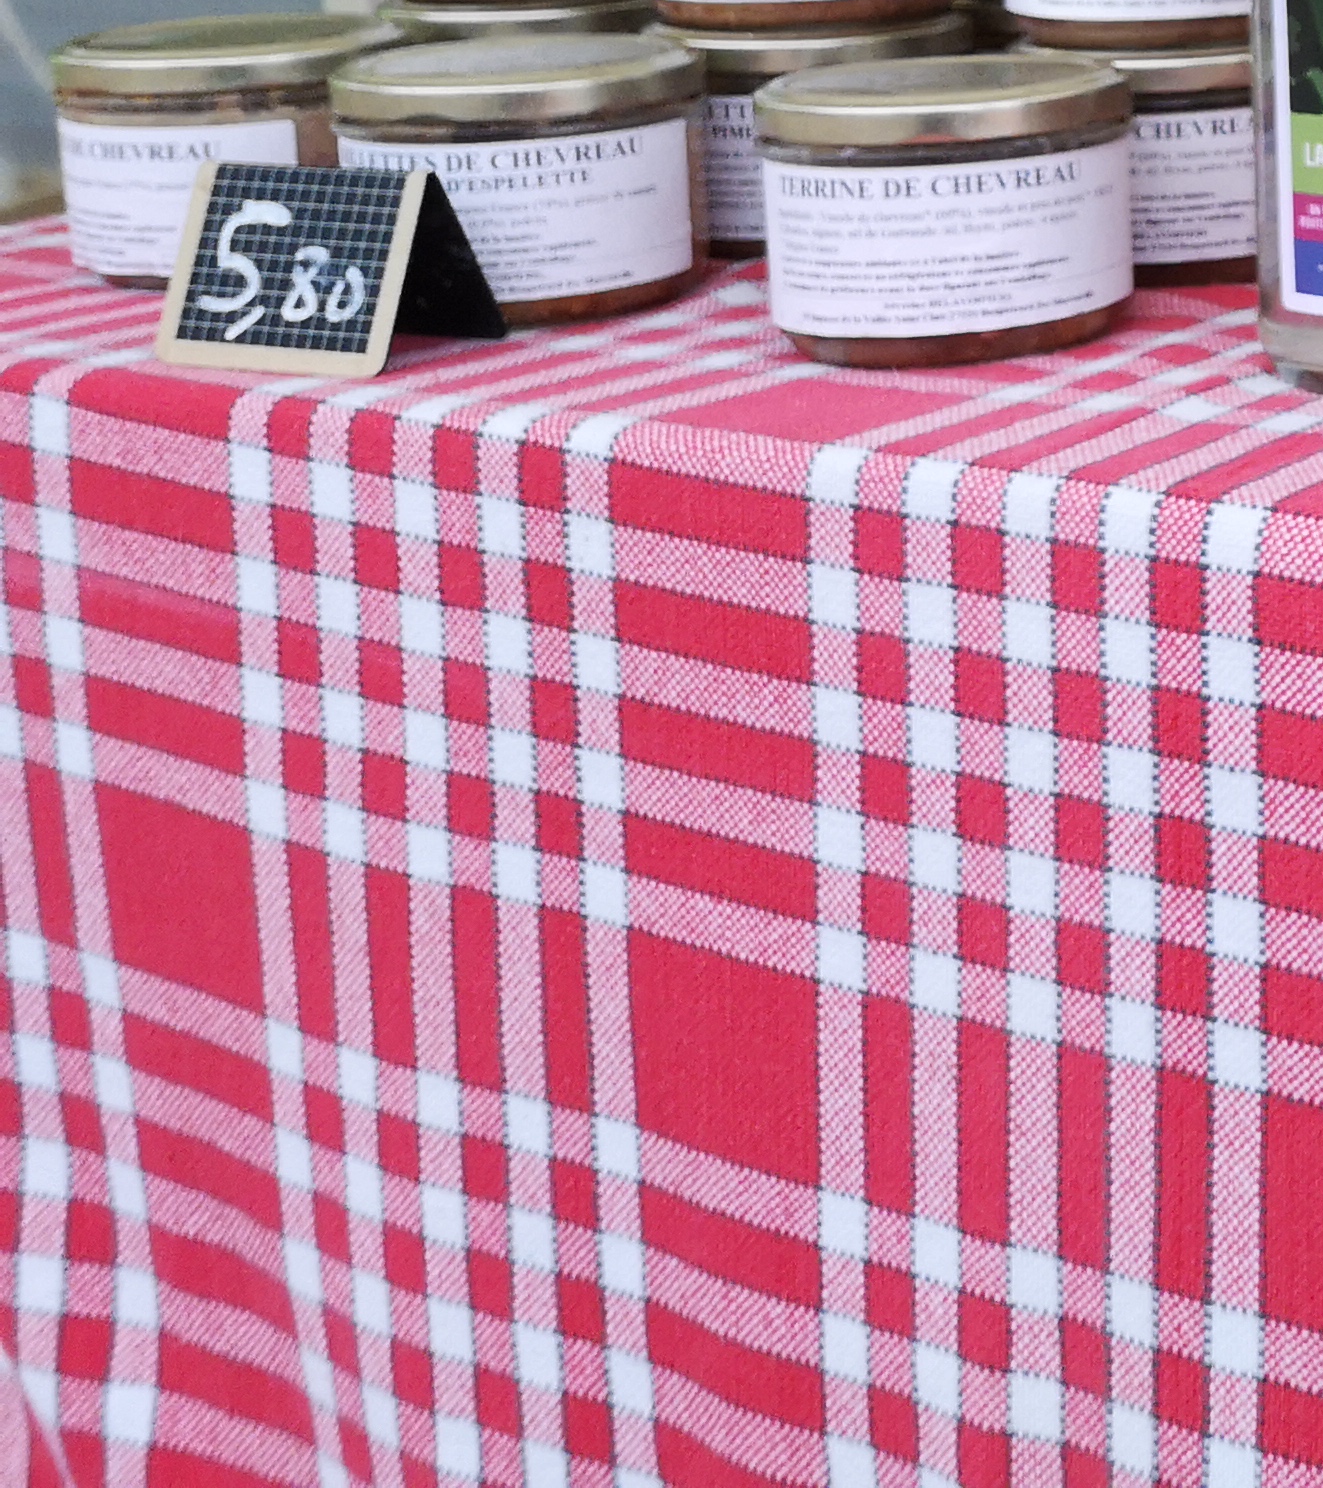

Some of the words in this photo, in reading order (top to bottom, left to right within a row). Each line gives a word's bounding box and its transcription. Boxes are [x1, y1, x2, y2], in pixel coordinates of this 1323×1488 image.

[1134, 116, 1239, 141] CHEVRE
[89, 140, 220, 161] CHEVREAU
[445, 151, 479, 173] DE
[490, 134, 644, 169] CHEVREAU
[779, 173, 875, 201] TERRINE
[883, 174, 923, 199] DE
[930, 160, 1083, 197] CHEVREAU
[197, 199, 366, 341] 5,80
